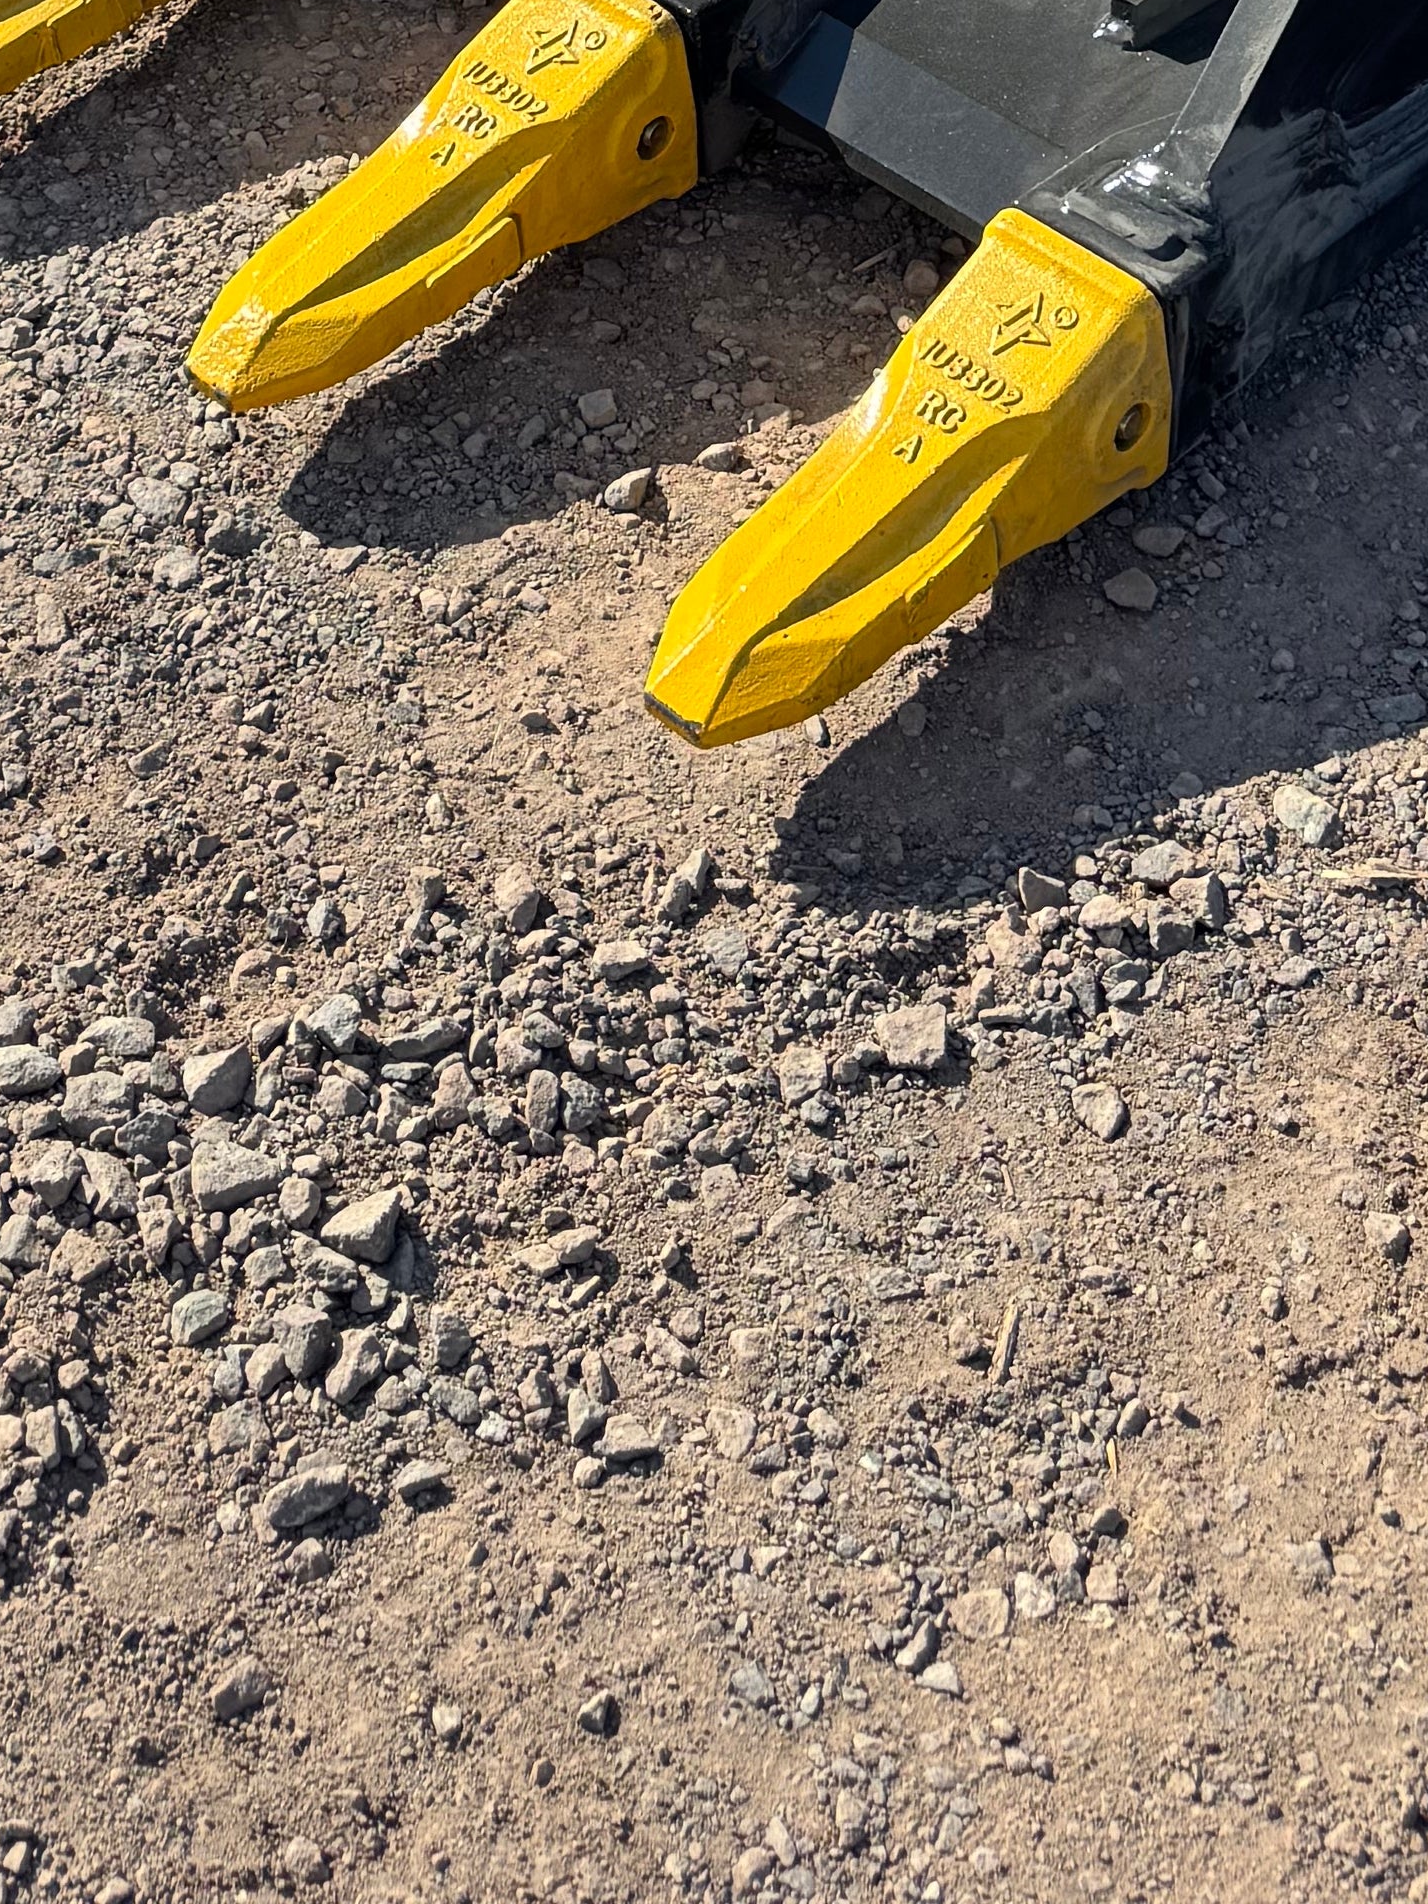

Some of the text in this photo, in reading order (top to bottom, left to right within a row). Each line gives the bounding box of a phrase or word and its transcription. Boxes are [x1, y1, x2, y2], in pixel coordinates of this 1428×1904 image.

[454, 103, 498, 140] RC
[431, 141, 456, 167] A
[915, 389, 968, 434] RC
[893, 435, 923, 465] A
